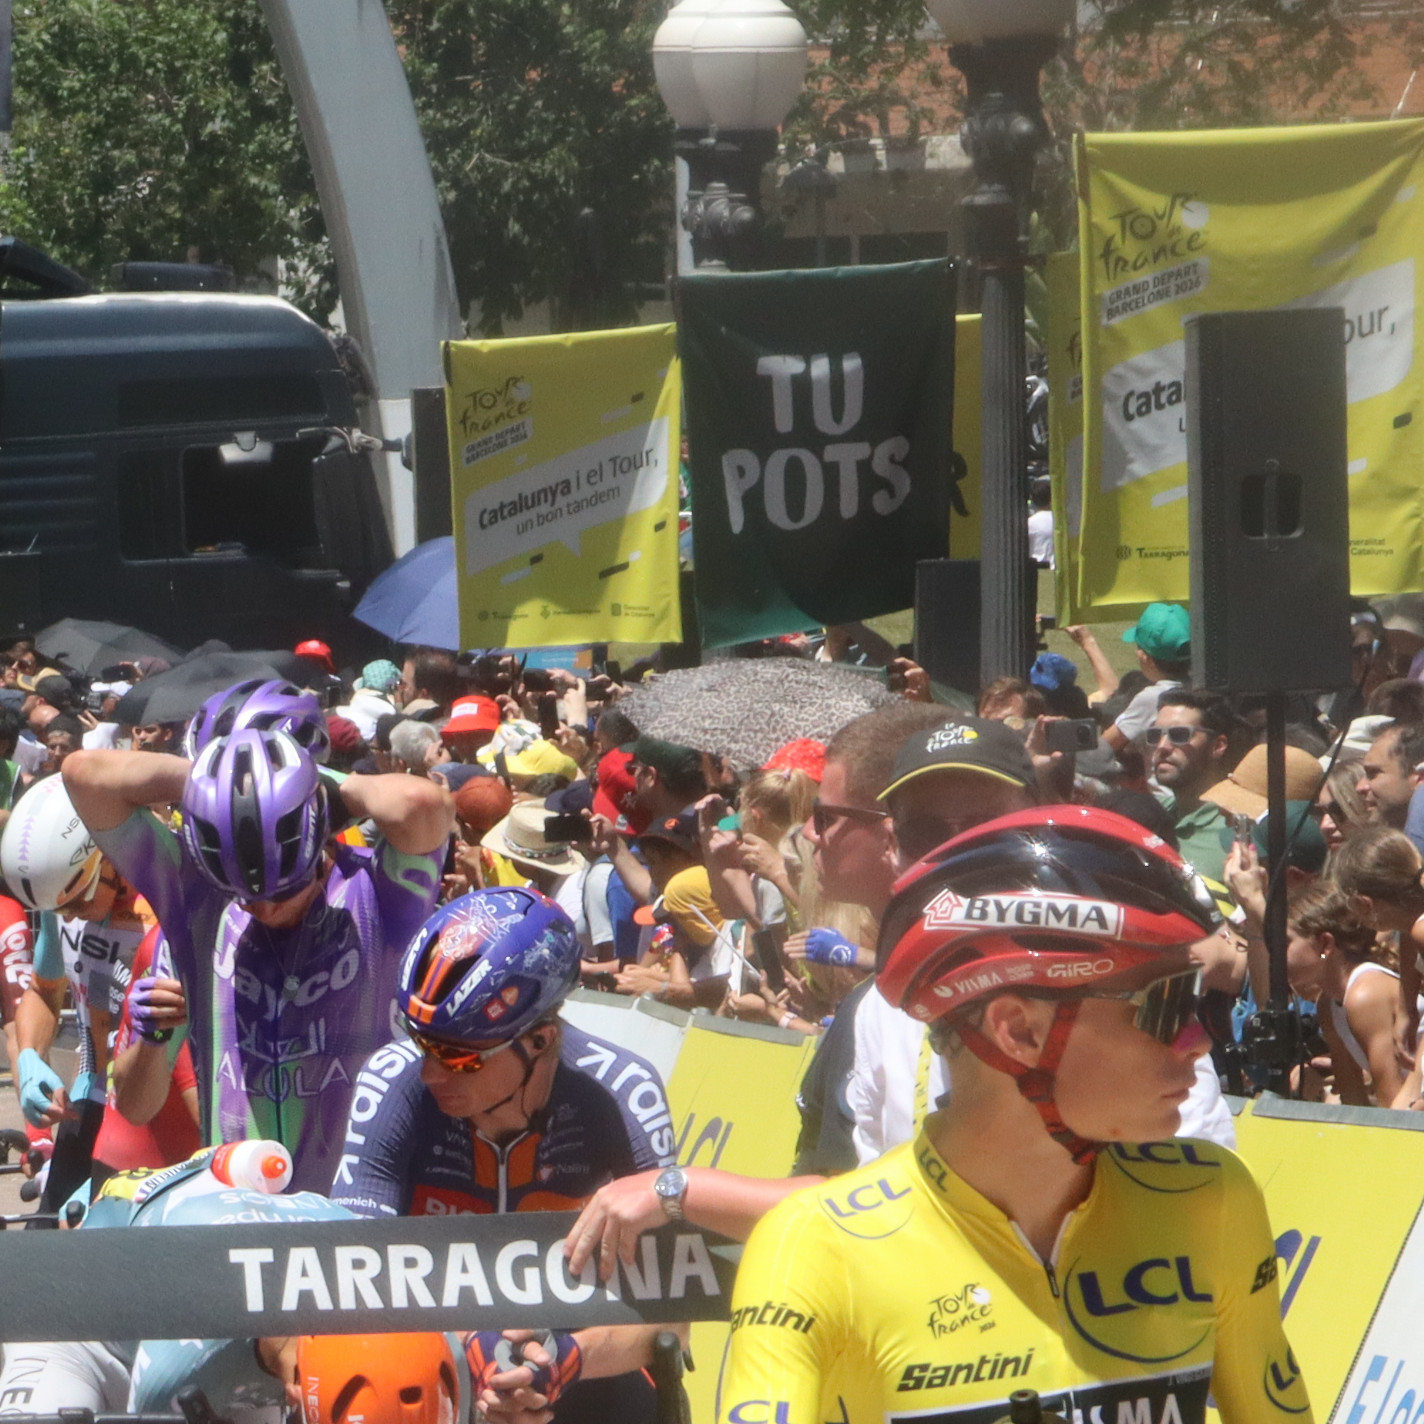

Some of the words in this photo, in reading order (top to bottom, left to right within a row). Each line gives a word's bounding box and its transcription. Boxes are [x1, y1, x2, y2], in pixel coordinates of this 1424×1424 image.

[1105, 288, 1173, 321] BARCELONE
[1174, 278, 1202, 297] 2026
[1108, 278, 1150, 302] GRAND
[757, 350, 865, 435] TU
[478, 478, 572, 530] Catalunya
[576, 471, 581, 490] i
[586, 460, 604, 485] el
[722, 433, 912, 536] POTS
[516, 518, 534, 536] un
[537, 507, 563, 527] bon
[964, 898, 1110, 931] BYGMA
[445, 958, 493, 1018] LAZER
[1047, 958, 1114, 978] GIRO
[822, 1177, 913, 1219] LCL
[229, 1233, 722, 1312] TARRAGONA
[1076, 1255, 1214, 1317] LCL
[897, 1347, 1036, 1392] Santini
